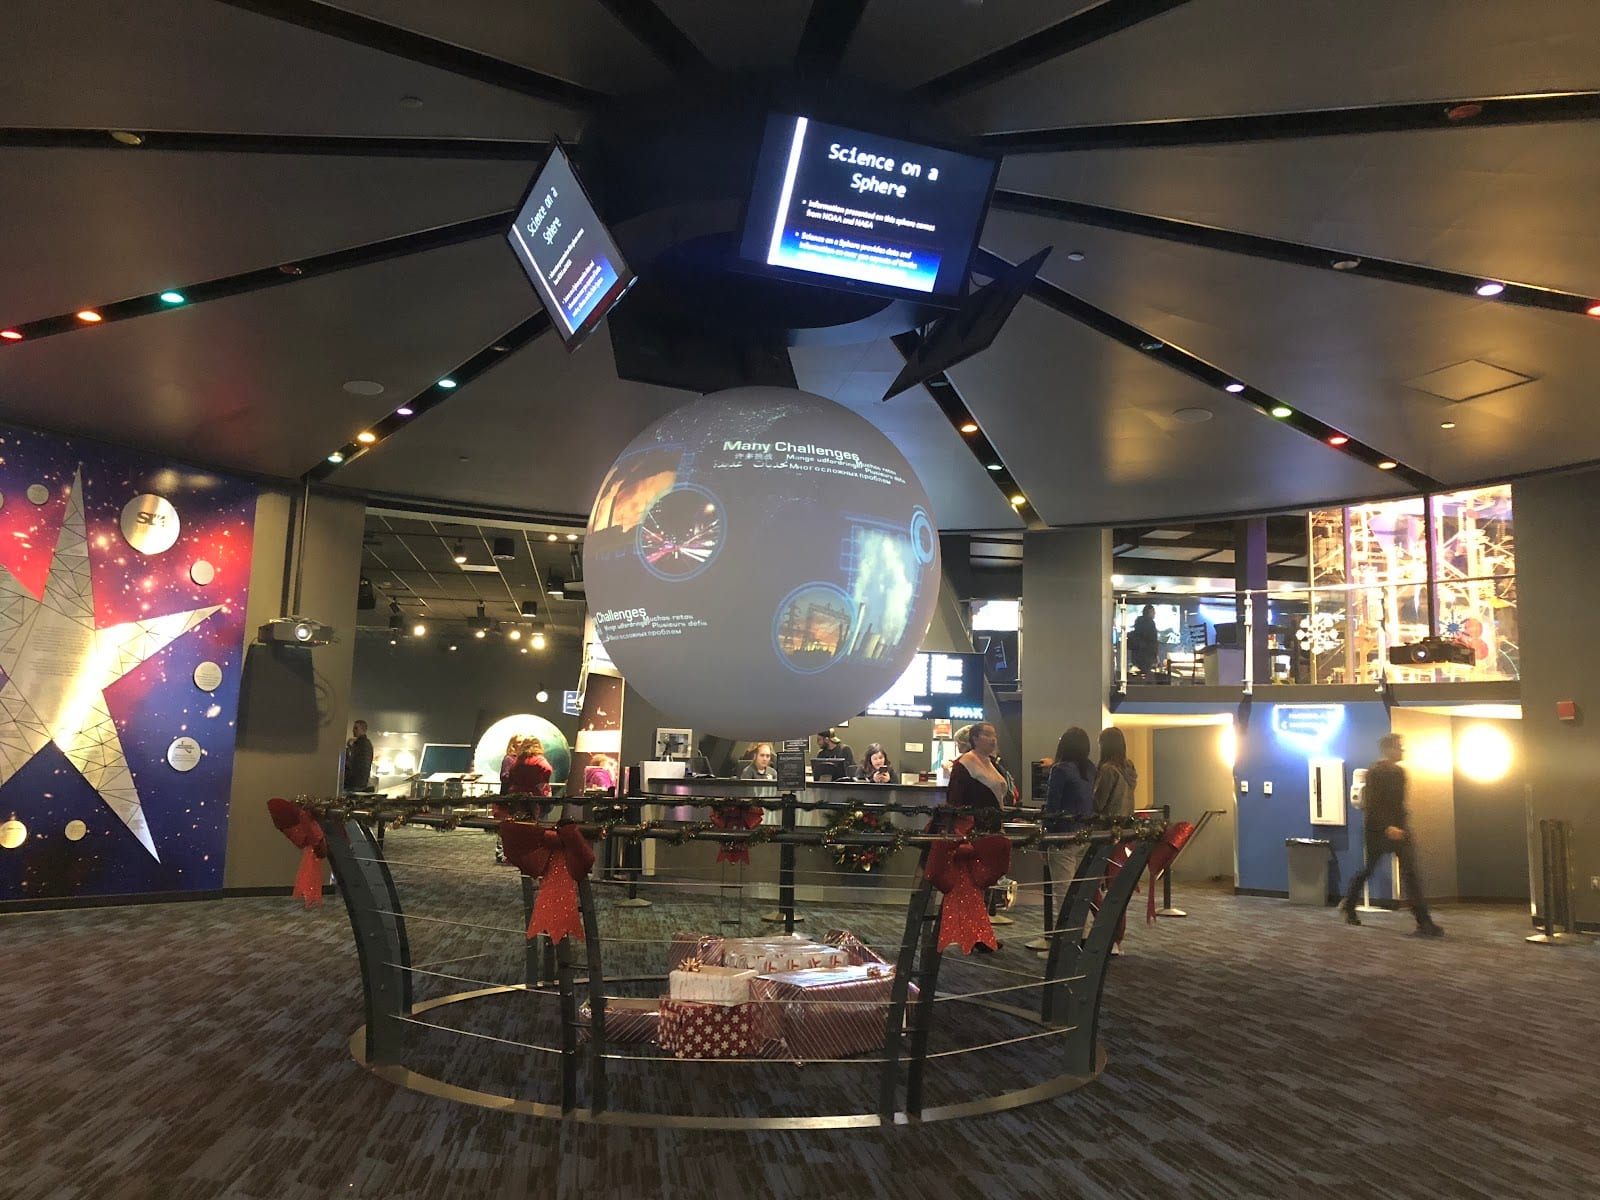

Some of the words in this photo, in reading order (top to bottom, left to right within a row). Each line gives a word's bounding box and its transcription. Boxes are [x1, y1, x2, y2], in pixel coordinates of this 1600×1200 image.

[829, 144, 894, 171] Science
[901, 160, 921, 178] on
[928, 167, 939, 181] a
[850, 172, 906, 198] Sphere
[527, 206, 547, 237] Science
[545, 194, 554, 208] on
[551, 186, 558, 198] a
[822, 212, 842, 223] NOAA
[543, 217, 562, 245] Sphere
[723, 441, 771, 453] Many
[774, 441, 860, 462] Challenges
[596, 607, 647, 624] Challenges
[651, 621, 686, 629] Plusieurs
